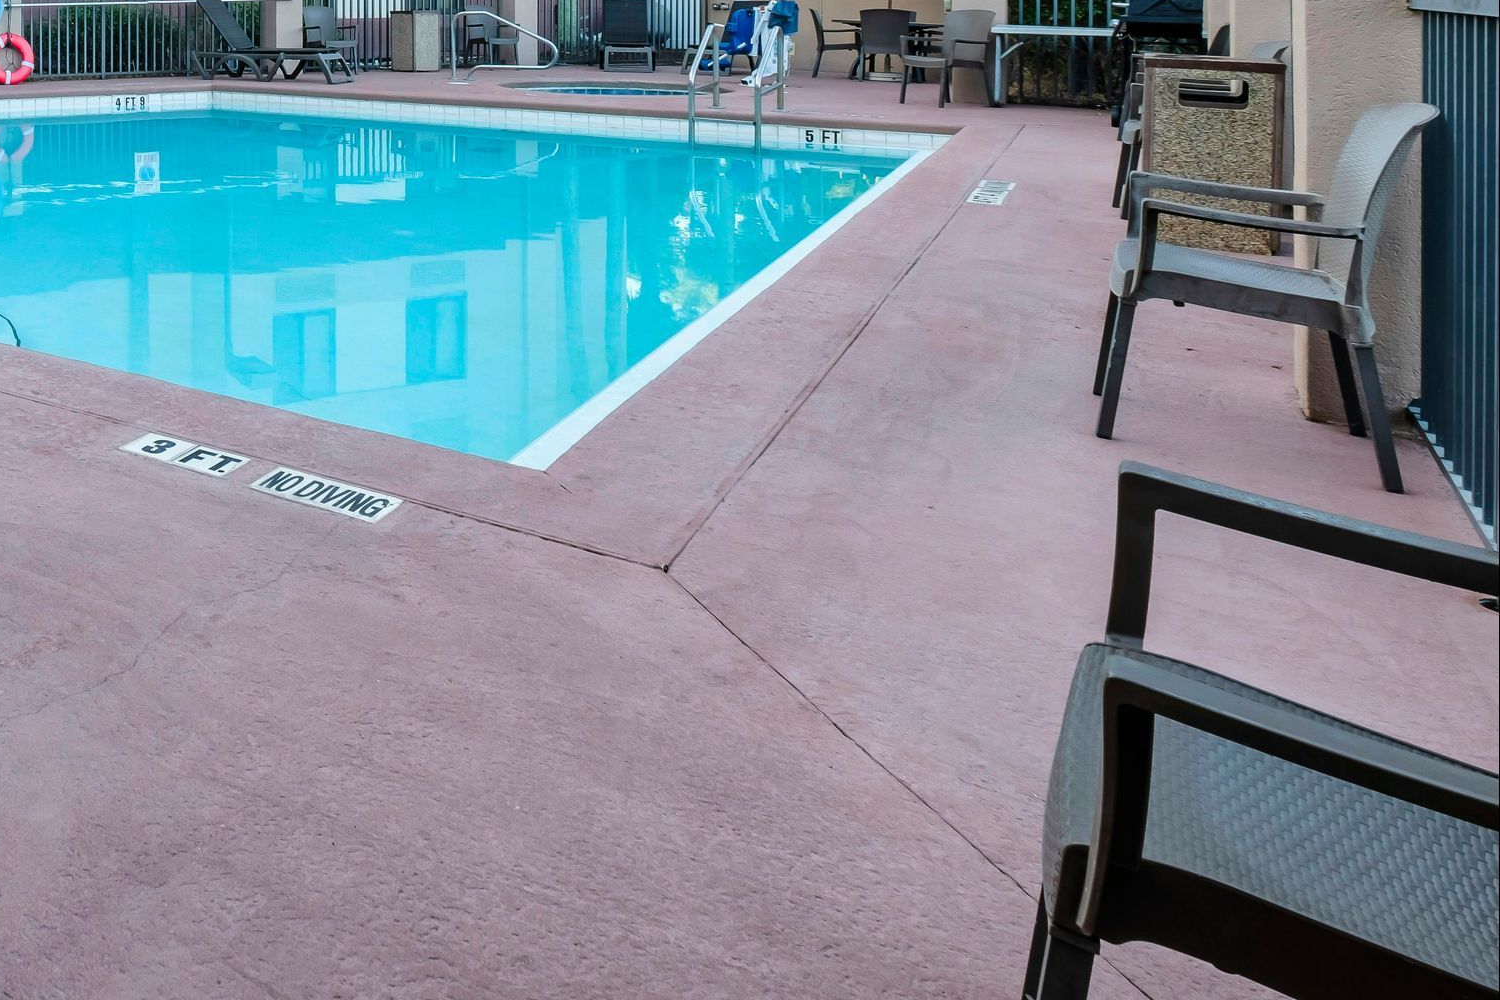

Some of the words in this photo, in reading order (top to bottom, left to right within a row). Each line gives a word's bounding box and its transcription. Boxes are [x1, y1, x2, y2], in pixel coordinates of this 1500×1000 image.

[125, 97, 136, 106] FT
[805, 130, 814, 143] 5
[822, 130, 841, 144] FT
[141, 439, 176, 454] 3
[179, 450, 242, 473] FT.
[258, 470, 302, 493] NO
[295, 480, 390, 518] DIVING
